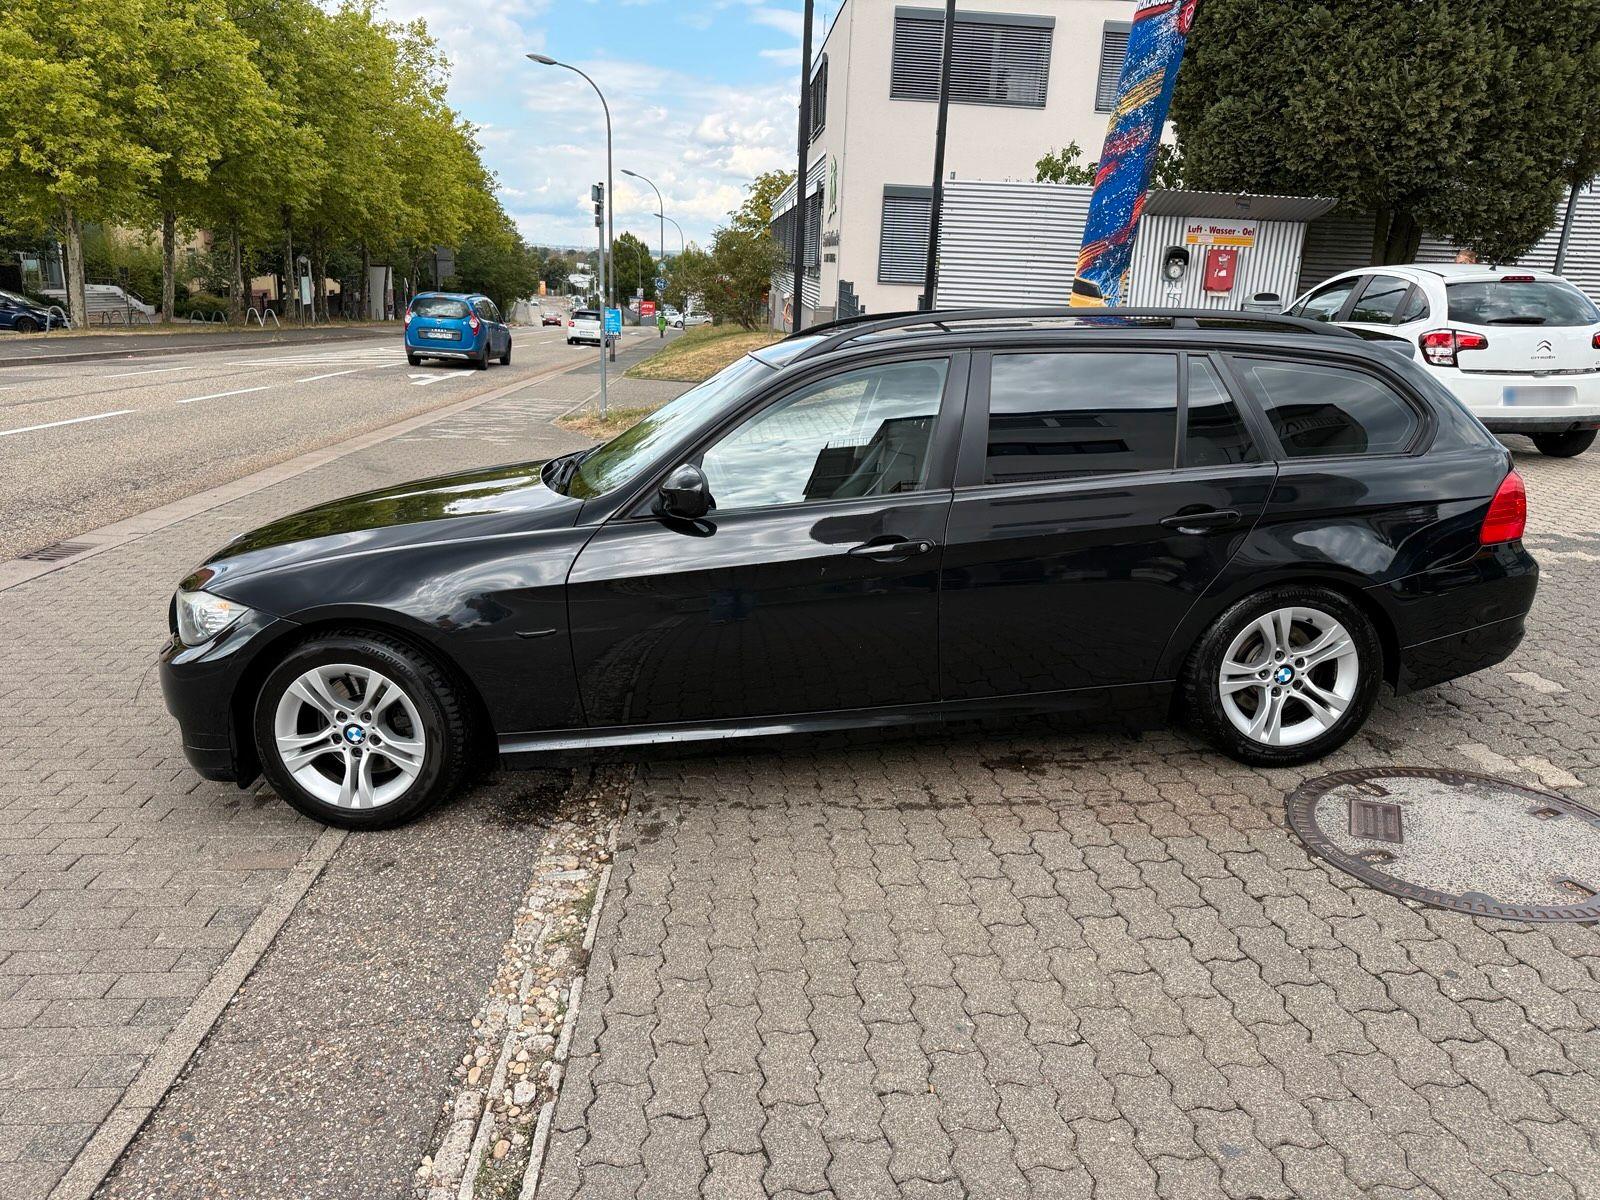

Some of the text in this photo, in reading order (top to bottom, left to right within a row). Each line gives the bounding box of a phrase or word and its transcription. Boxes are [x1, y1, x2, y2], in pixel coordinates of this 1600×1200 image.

[1188, 224, 1256, 236] Luft Wasser Oel
